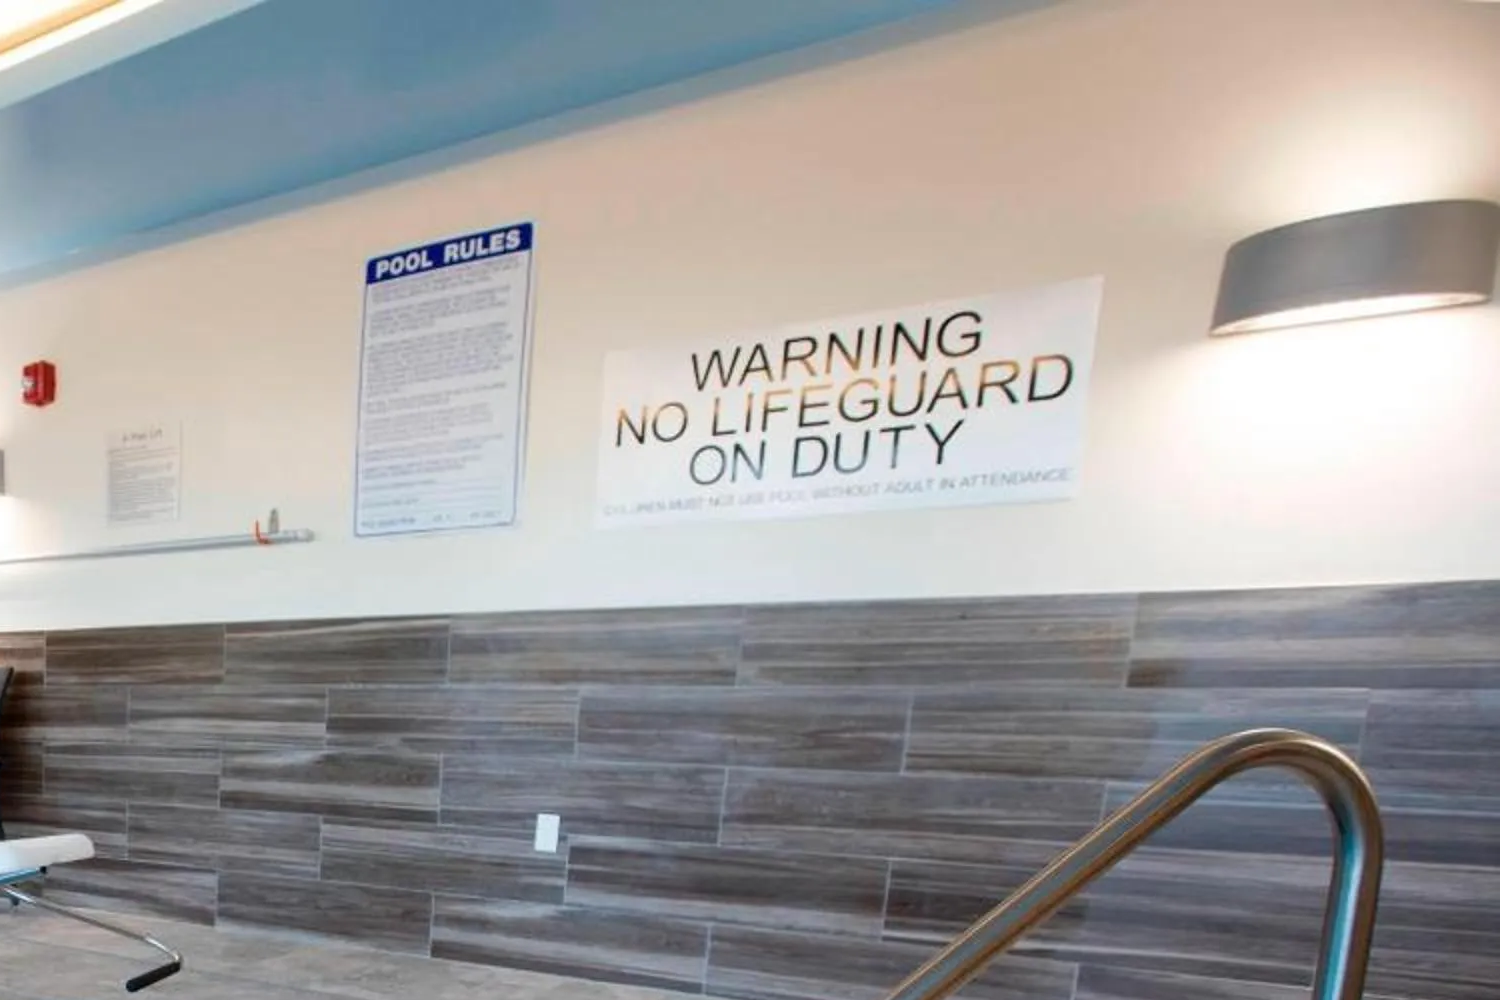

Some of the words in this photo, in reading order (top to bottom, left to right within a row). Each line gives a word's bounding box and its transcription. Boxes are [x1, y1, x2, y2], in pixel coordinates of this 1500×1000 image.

[374, 249, 434, 279] POOL
[443, 228, 521, 264] RULES
[691, 310, 984, 393] WARNING
[614, 401, 689, 448] NO
[711, 353, 1075, 438] LIFEGUARD
[689, 439, 767, 486] ON
[790, 419, 965, 479] DUTY
[884, 478, 933, 494] ADULT
[939, 477, 956, 490] IN
[959, 467, 1070, 488] ATTENDANCE
